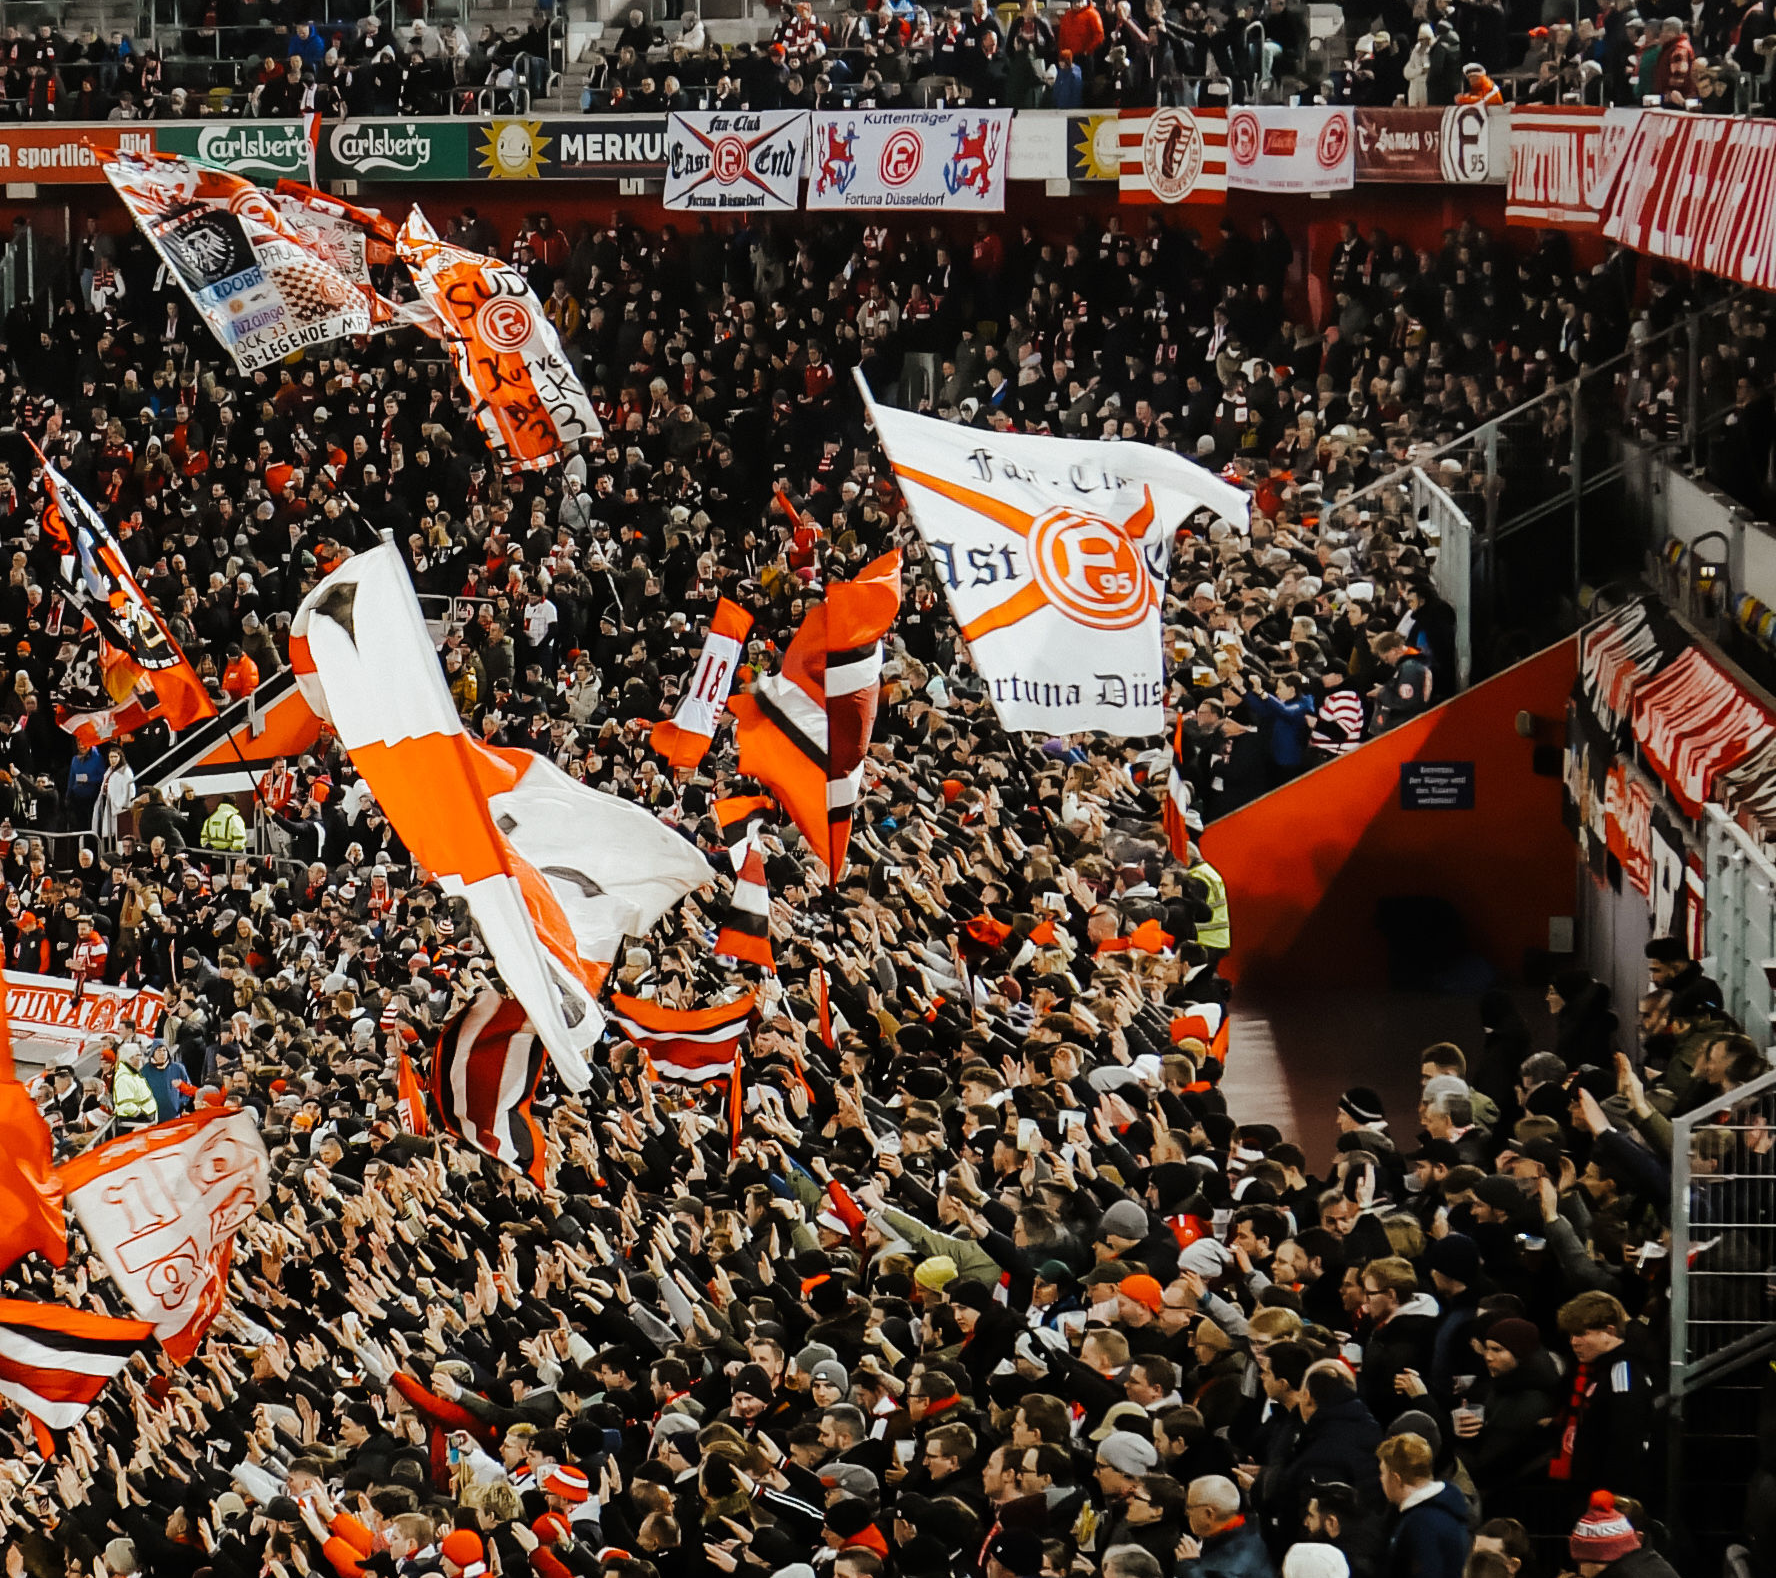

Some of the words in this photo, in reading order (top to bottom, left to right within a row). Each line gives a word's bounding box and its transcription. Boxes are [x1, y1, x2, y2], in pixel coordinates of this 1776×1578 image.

[330, 124, 431, 173] Carlsberg
[754, 139, 797, 179] End
[845, 192, 882, 206] Fortuna
[885, 192, 946, 206] Düsseldorf
[693, 651, 729, 703] 18
[987, 677, 1081, 708] rtuna
